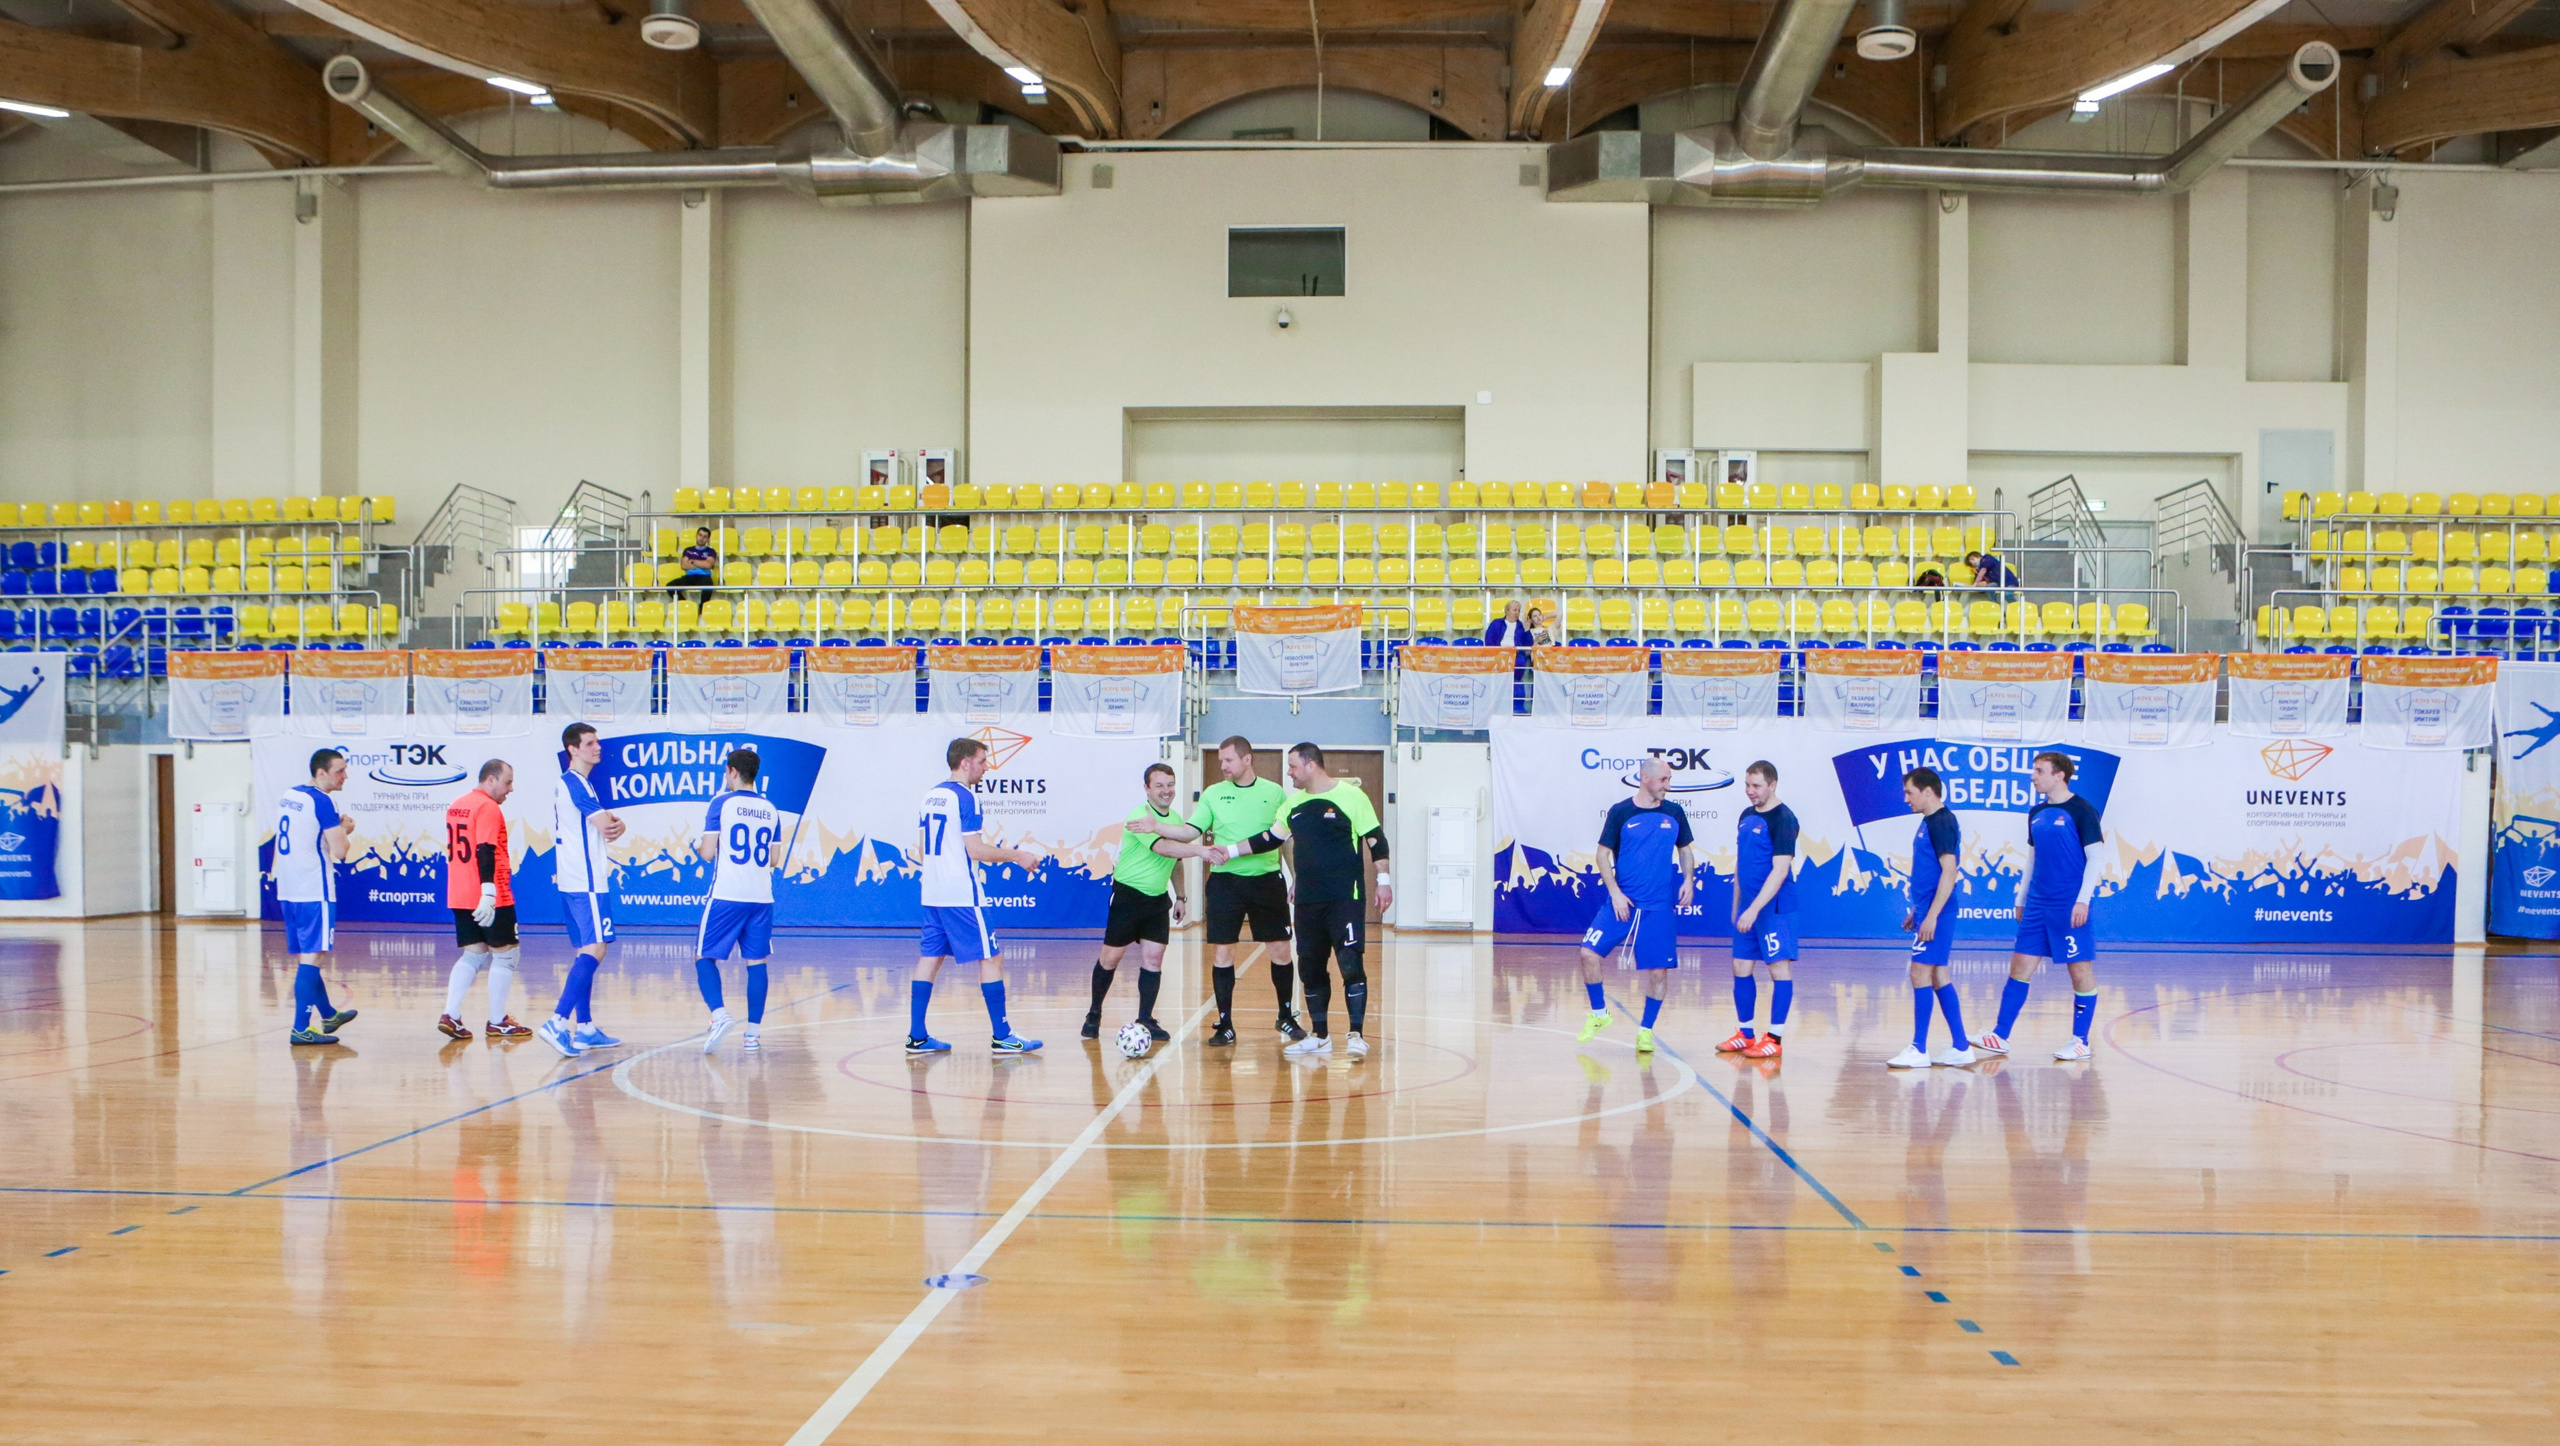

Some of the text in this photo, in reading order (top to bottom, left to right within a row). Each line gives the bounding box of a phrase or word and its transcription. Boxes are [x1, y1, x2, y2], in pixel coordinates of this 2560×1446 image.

[1868, 746, 2081, 781] У НАС ОБЩЕ
[372, 792, 429, 800] ТУРНИРЫ ПРИ
[2246, 790, 2346, 806] UNEVENTS
[350, 804, 400, 812] ПОДДЕРЖКЕ
[736, 806, 772, 820] СВИЩЁВ
[2293, 820, 2346, 828] МЕРОПРИЯТИЯ
[278, 814, 290, 856] 8
[920, 812, 948, 856] 17
[729, 822, 772, 868] 98
[368, 888, 436, 906] #спорттэк
[2254, 908, 2333, 922] #unevents
[602, 917, 614, 936] 2
[1346, 922, 1354, 941] 1
[1764, 932, 1781, 952] 15
[2065, 936, 2078, 954] 3
